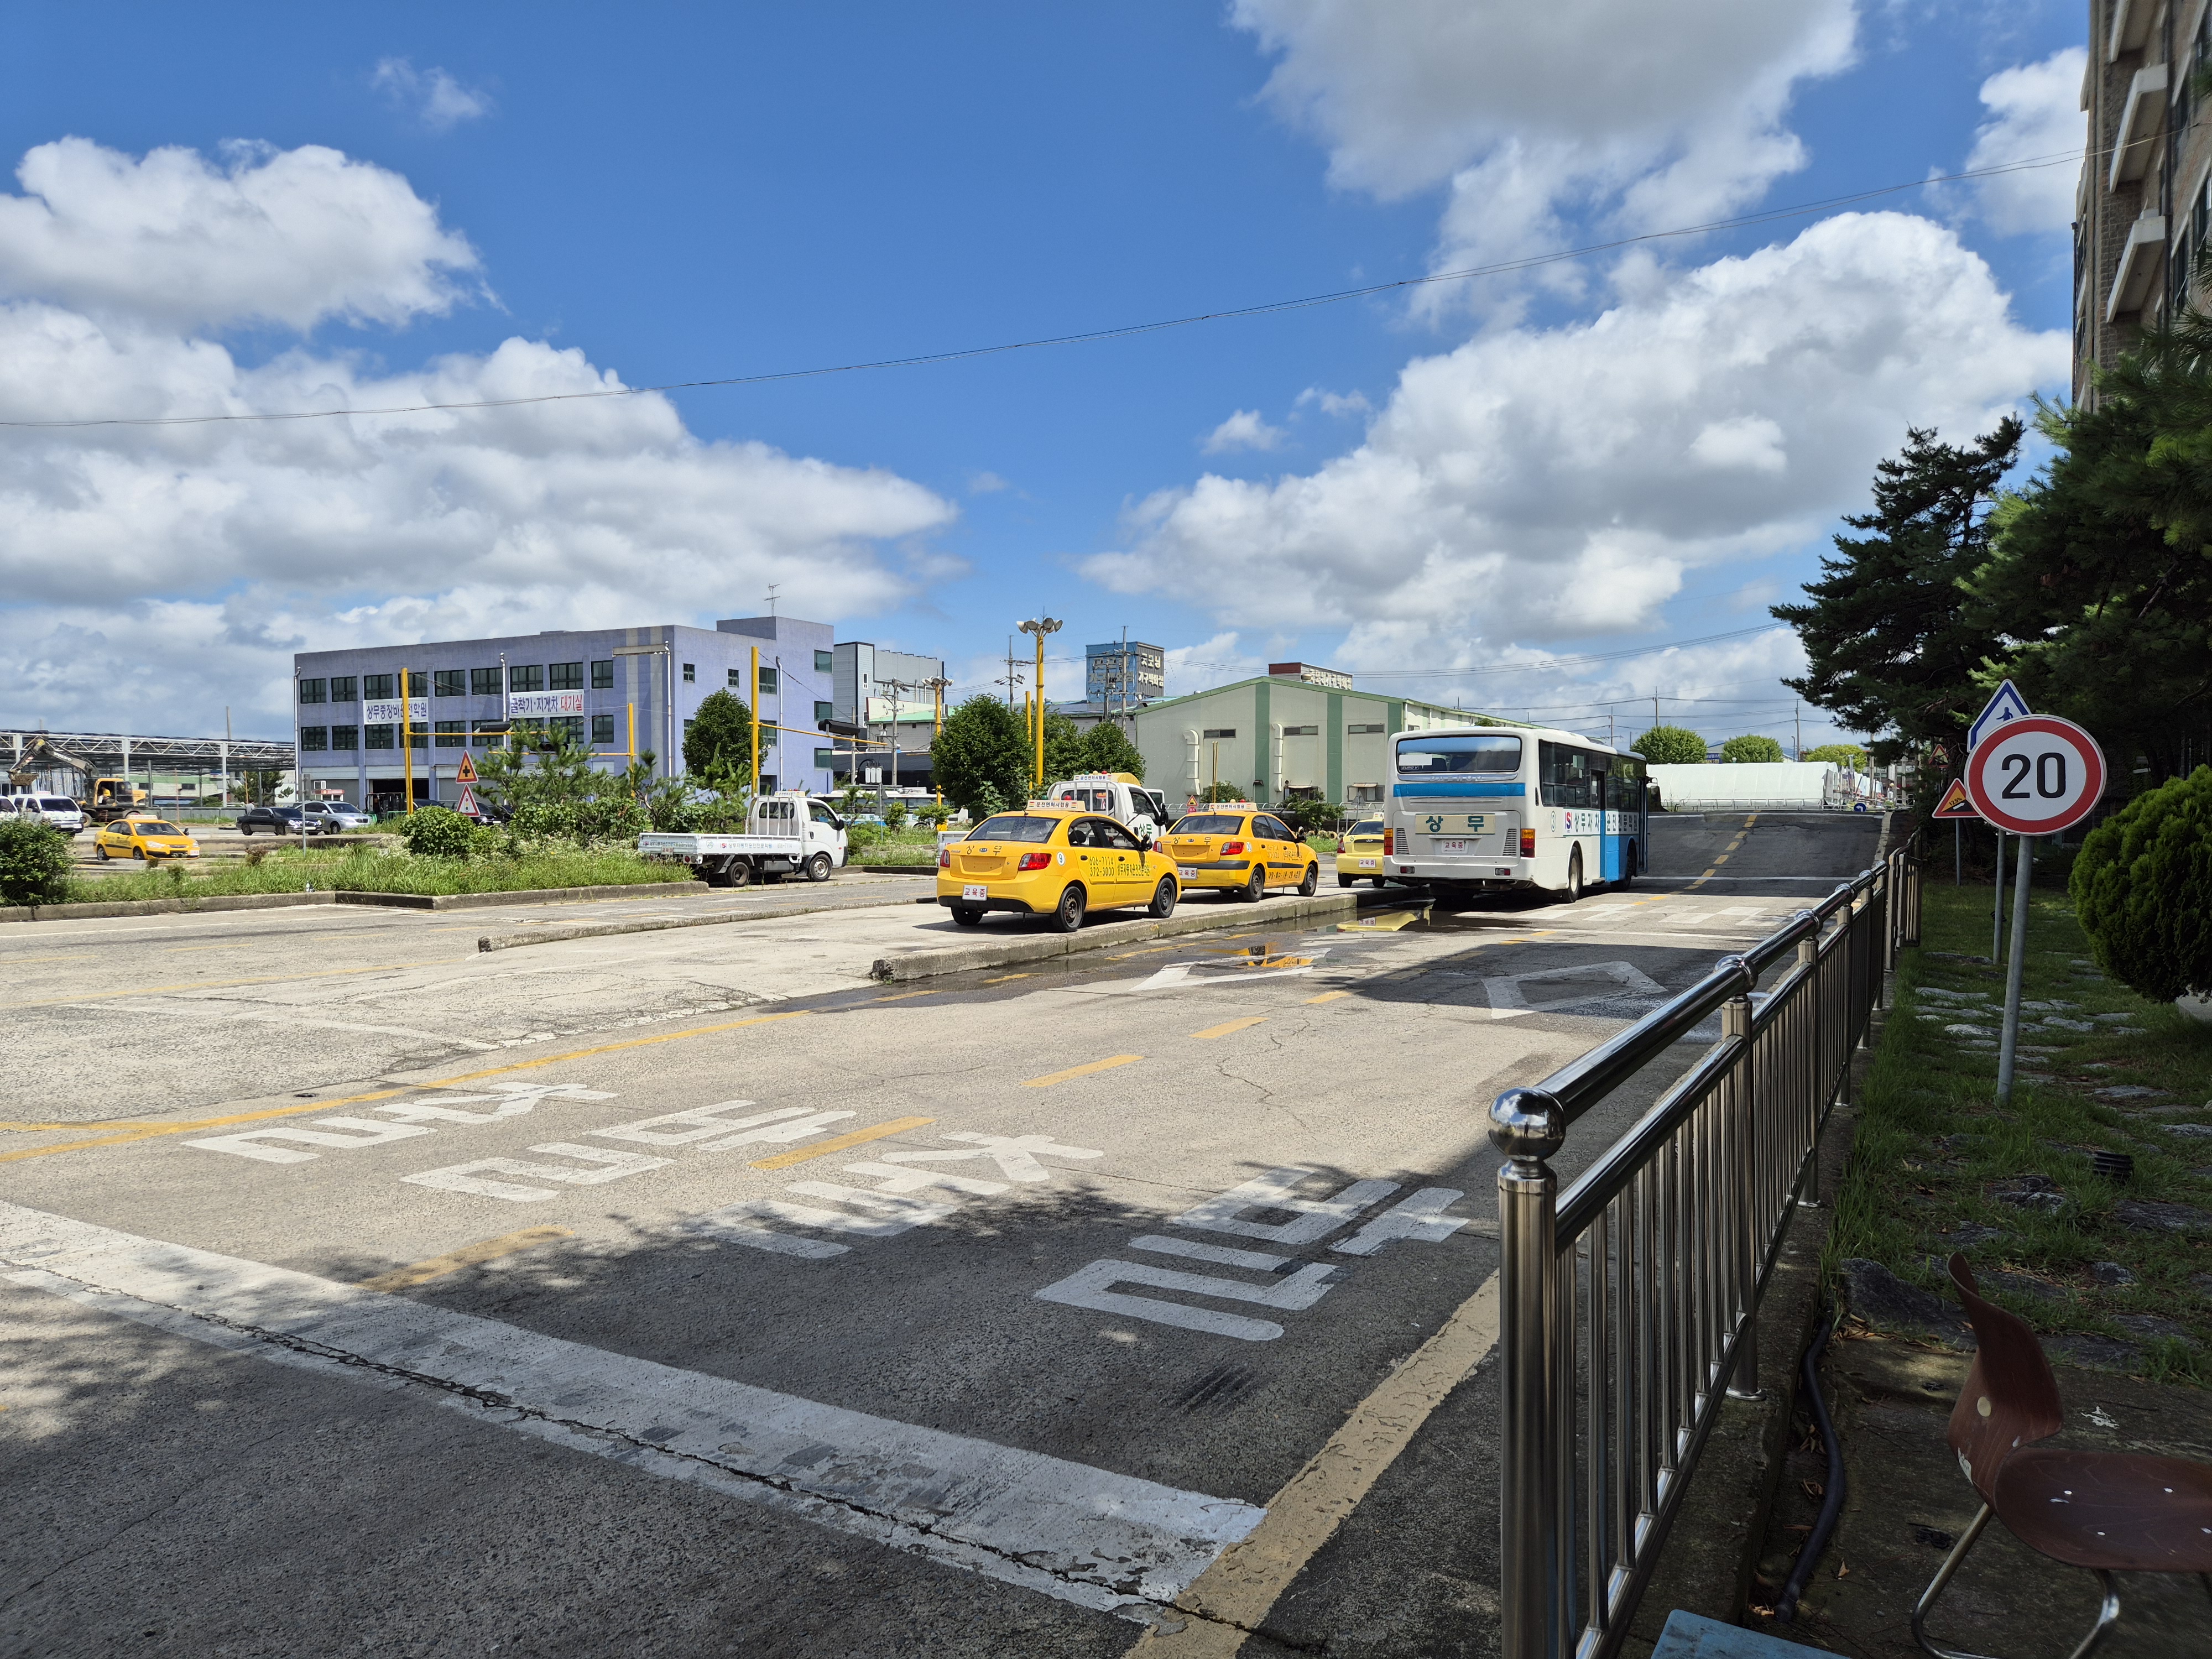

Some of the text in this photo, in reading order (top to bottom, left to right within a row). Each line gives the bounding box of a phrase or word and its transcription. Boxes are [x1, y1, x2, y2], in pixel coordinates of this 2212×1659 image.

[1141, 653, 1161, 669] 굿모닝
[1138, 671, 1164, 686] 가구백화점
[510, 694, 582, 713] 굴착기·지게차 대기실
[2001, 752, 2067, 799] 20
[1058, 853, 1063, 863] 9
[1089, 856, 1114, 866] 606-7114
[1090, 867, 1114, 877] 372-3000
[964, 888, 985, 898] 교육중
